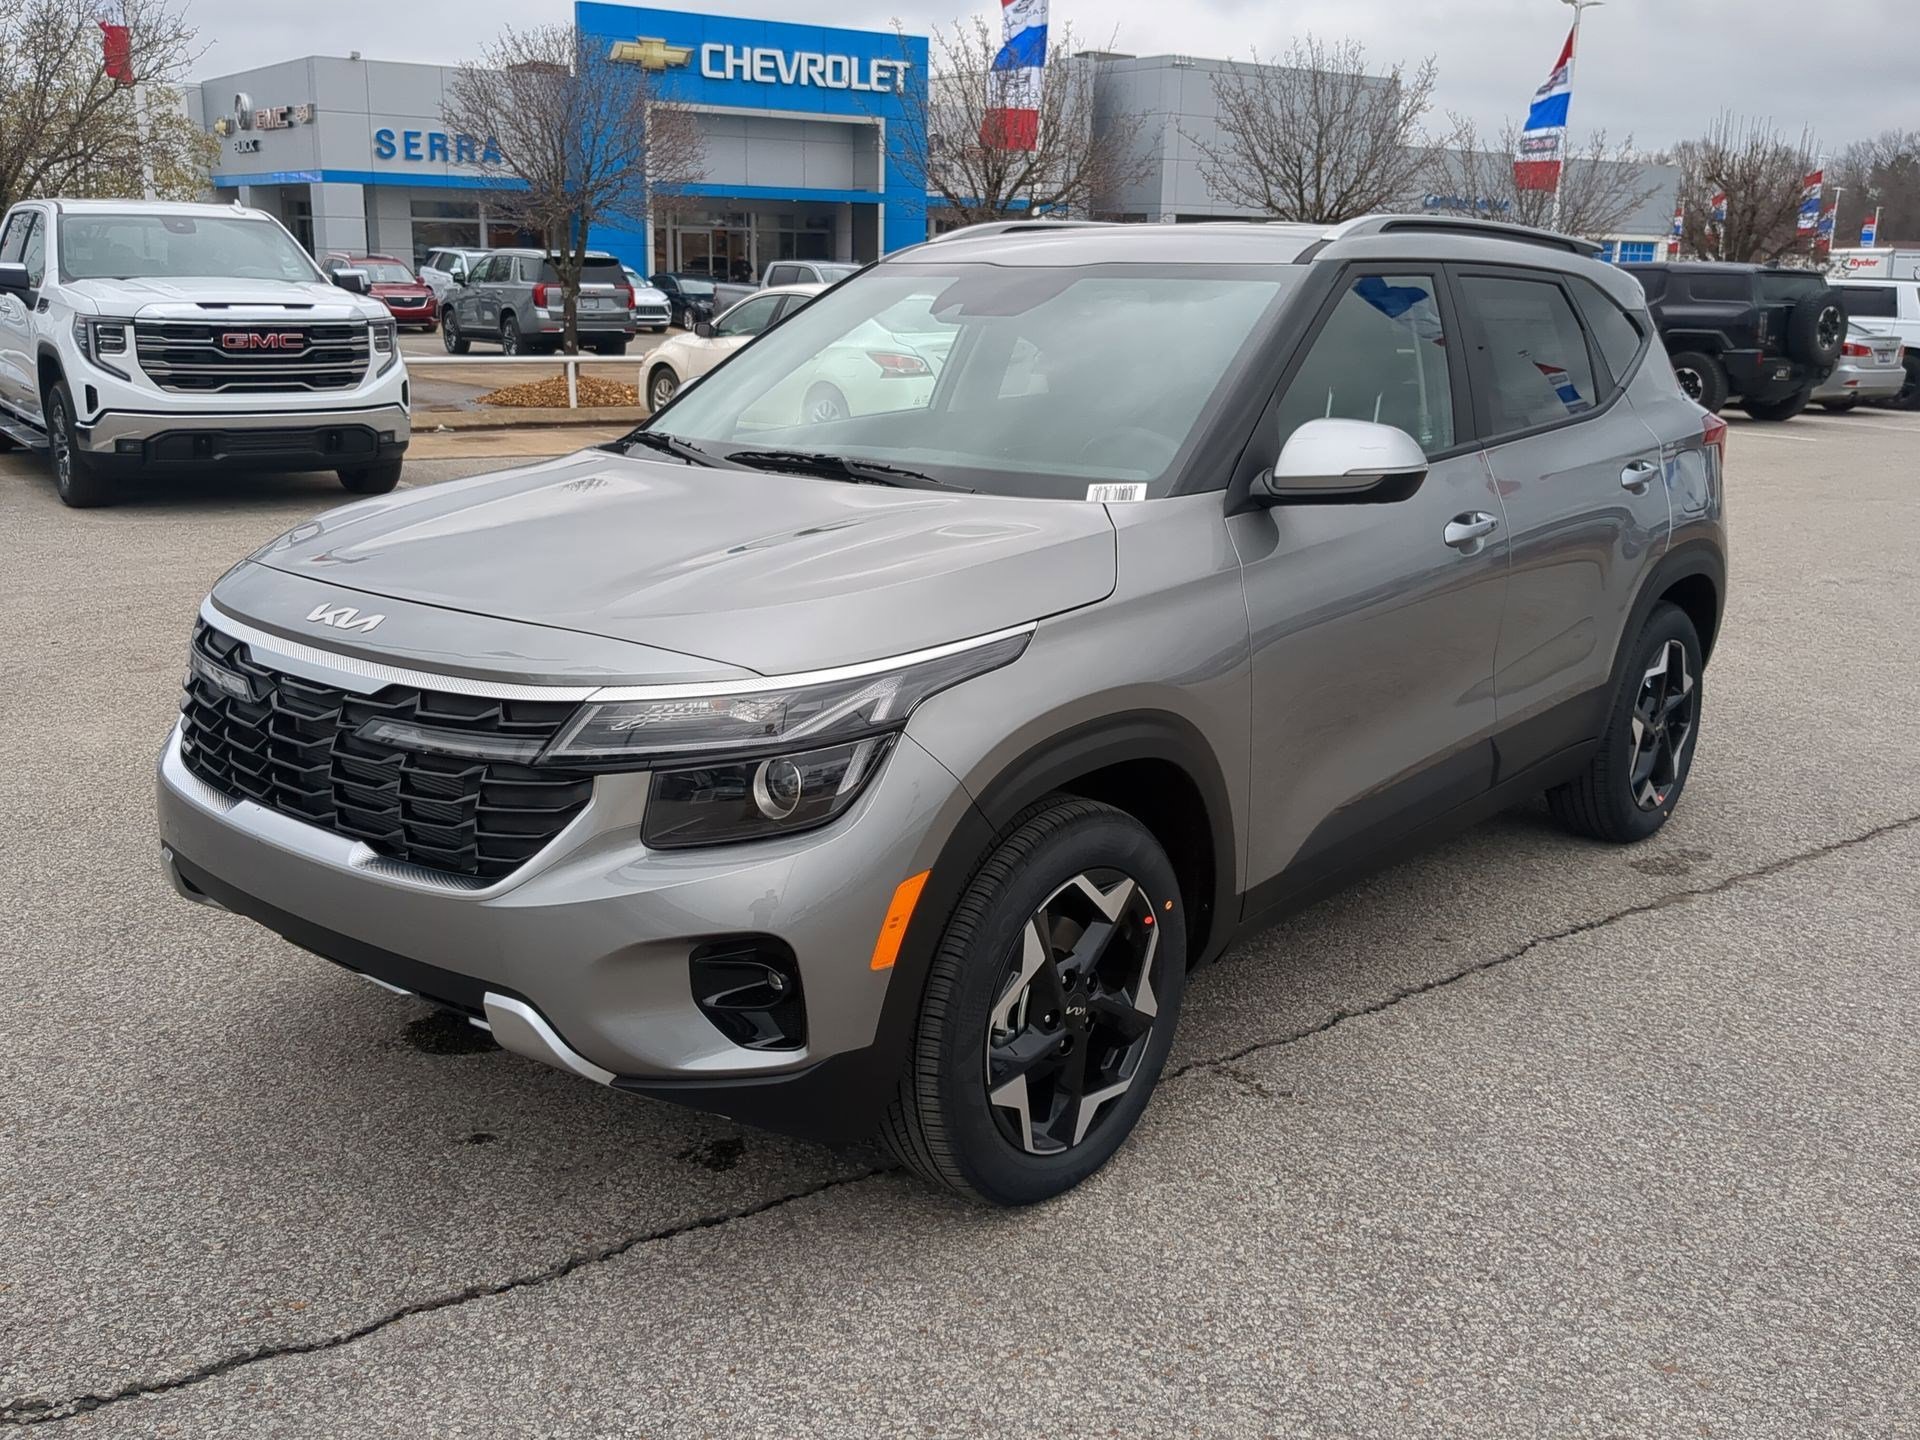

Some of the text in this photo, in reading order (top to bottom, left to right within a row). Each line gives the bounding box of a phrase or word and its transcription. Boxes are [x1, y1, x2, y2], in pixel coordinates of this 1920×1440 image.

[701, 42, 911, 94] CHEVROLET
[255, 106, 291, 130] GMC
[233, 139, 257, 154] BUICK
[374, 128, 502, 164] SERRA
[1849, 258, 1878, 268] Ryder
[222, 333, 304, 349] GMC
[306, 602, 386, 634] KIA
